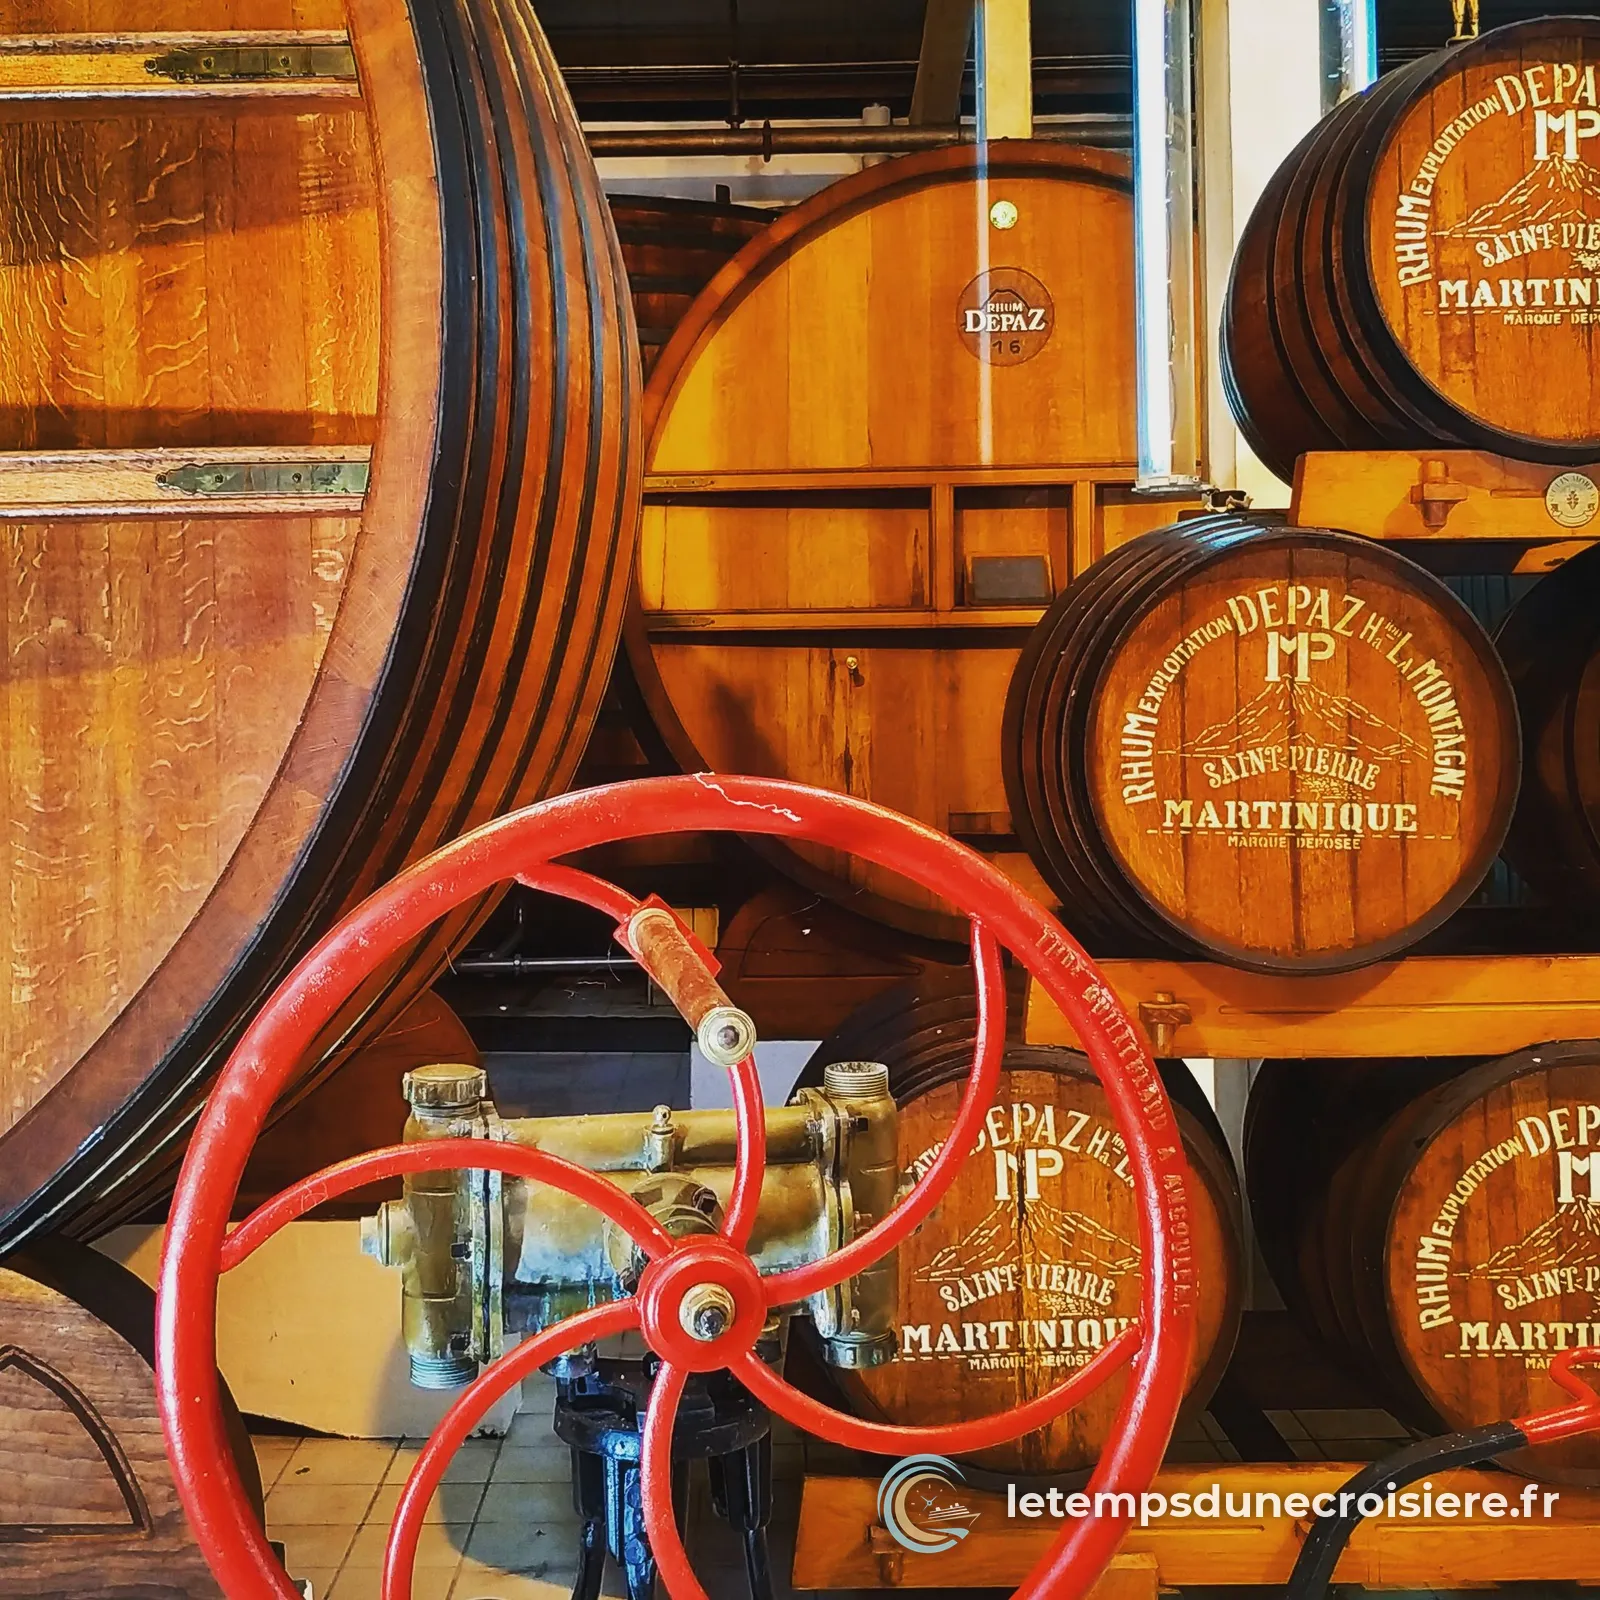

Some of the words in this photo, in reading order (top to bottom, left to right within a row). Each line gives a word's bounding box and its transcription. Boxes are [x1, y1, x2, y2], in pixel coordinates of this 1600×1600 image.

[1494, 63, 1600, 117] DEPA
[1410, 94, 1502, 197] EXPLOITATION
[1533, 109, 1600, 161] MP
[1394, 194, 1433, 288] RHUM
[1475, 222, 1555, 268] SAINT
[1560, 219, 1600, 251] PIE
[987, 302, 1023, 313] RHUM
[1438, 278, 1600, 308] MARTIN
[964, 308, 1046, 332] DEPAZ
[1503, 313, 1562, 325] MARQUE
[1570, 313, 1600, 325] DEP
[991, 339, 1021, 354] 16
[1226, 585, 1366, 637] DEPAZ
[1138, 614, 1235, 714] EXPLOITATION
[1264, 632, 1336, 683] MP
[1406, 658, 1468, 802] MONTAGNE
[1121, 711, 1159, 806] RHUM
[1203, 745, 1282, 789] SAINT
[1289, 745, 1381, 791] PIERRE
[1162, 799, 1418, 833] MARTINIQUE
[1227, 835, 1288, 849] MARQUE
[1296, 836, 1362, 850] DEPOSEE
[1517, 1104, 1600, 1158] DEP
[1431, 1135, 1525, 1239] EXPLOITATION
[939, 1263, 1019, 1312] SAINT
[1415, 1236, 1454, 1330] RHUM
[1496, 1266, 1578, 1311] SAINT
[901, 1317, 1139, 1354] MARTINIQU
